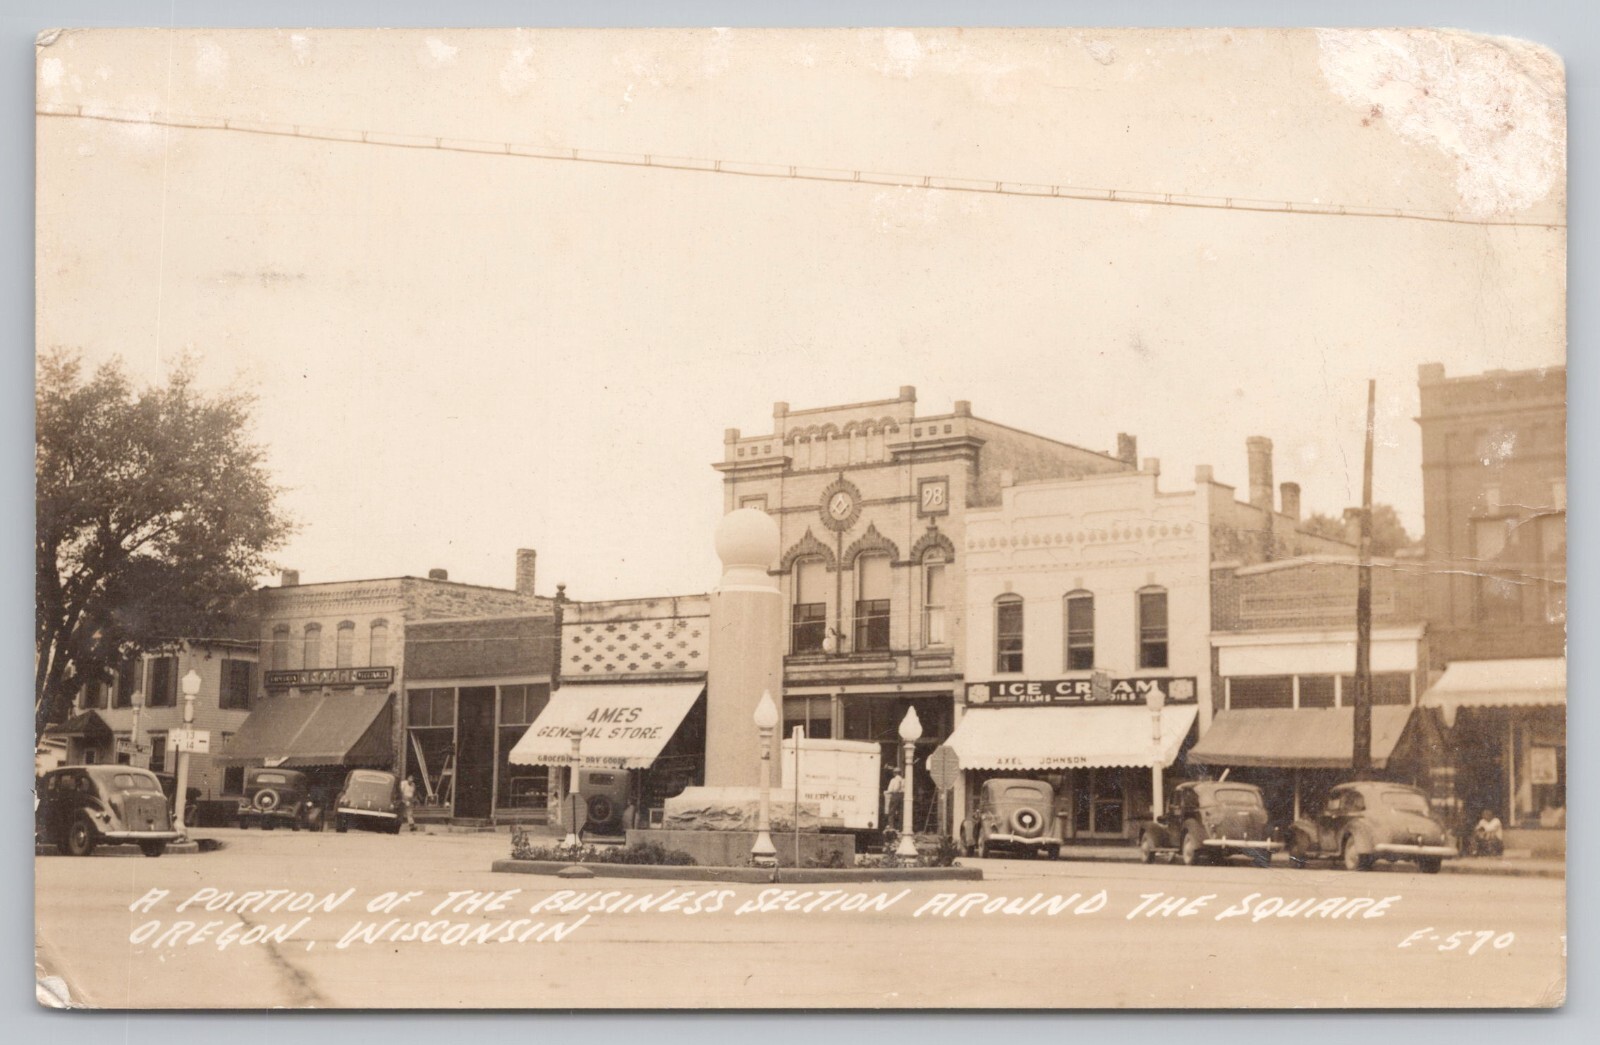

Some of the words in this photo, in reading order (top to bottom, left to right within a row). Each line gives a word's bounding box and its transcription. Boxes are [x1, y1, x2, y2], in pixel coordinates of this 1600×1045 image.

[923, 486, 944, 507] 98
[998, 683, 1042, 696] ICE
[1055, 680, 1160, 695] CRAM
[1018, 694, 1052, 703] FILMS
[586, 707, 643, 724] AMES
[585, 756, 600, 764] DRY
[996, 757, 1023, 765] AXEL
[1039, 756, 1087, 765] JOHNSON
